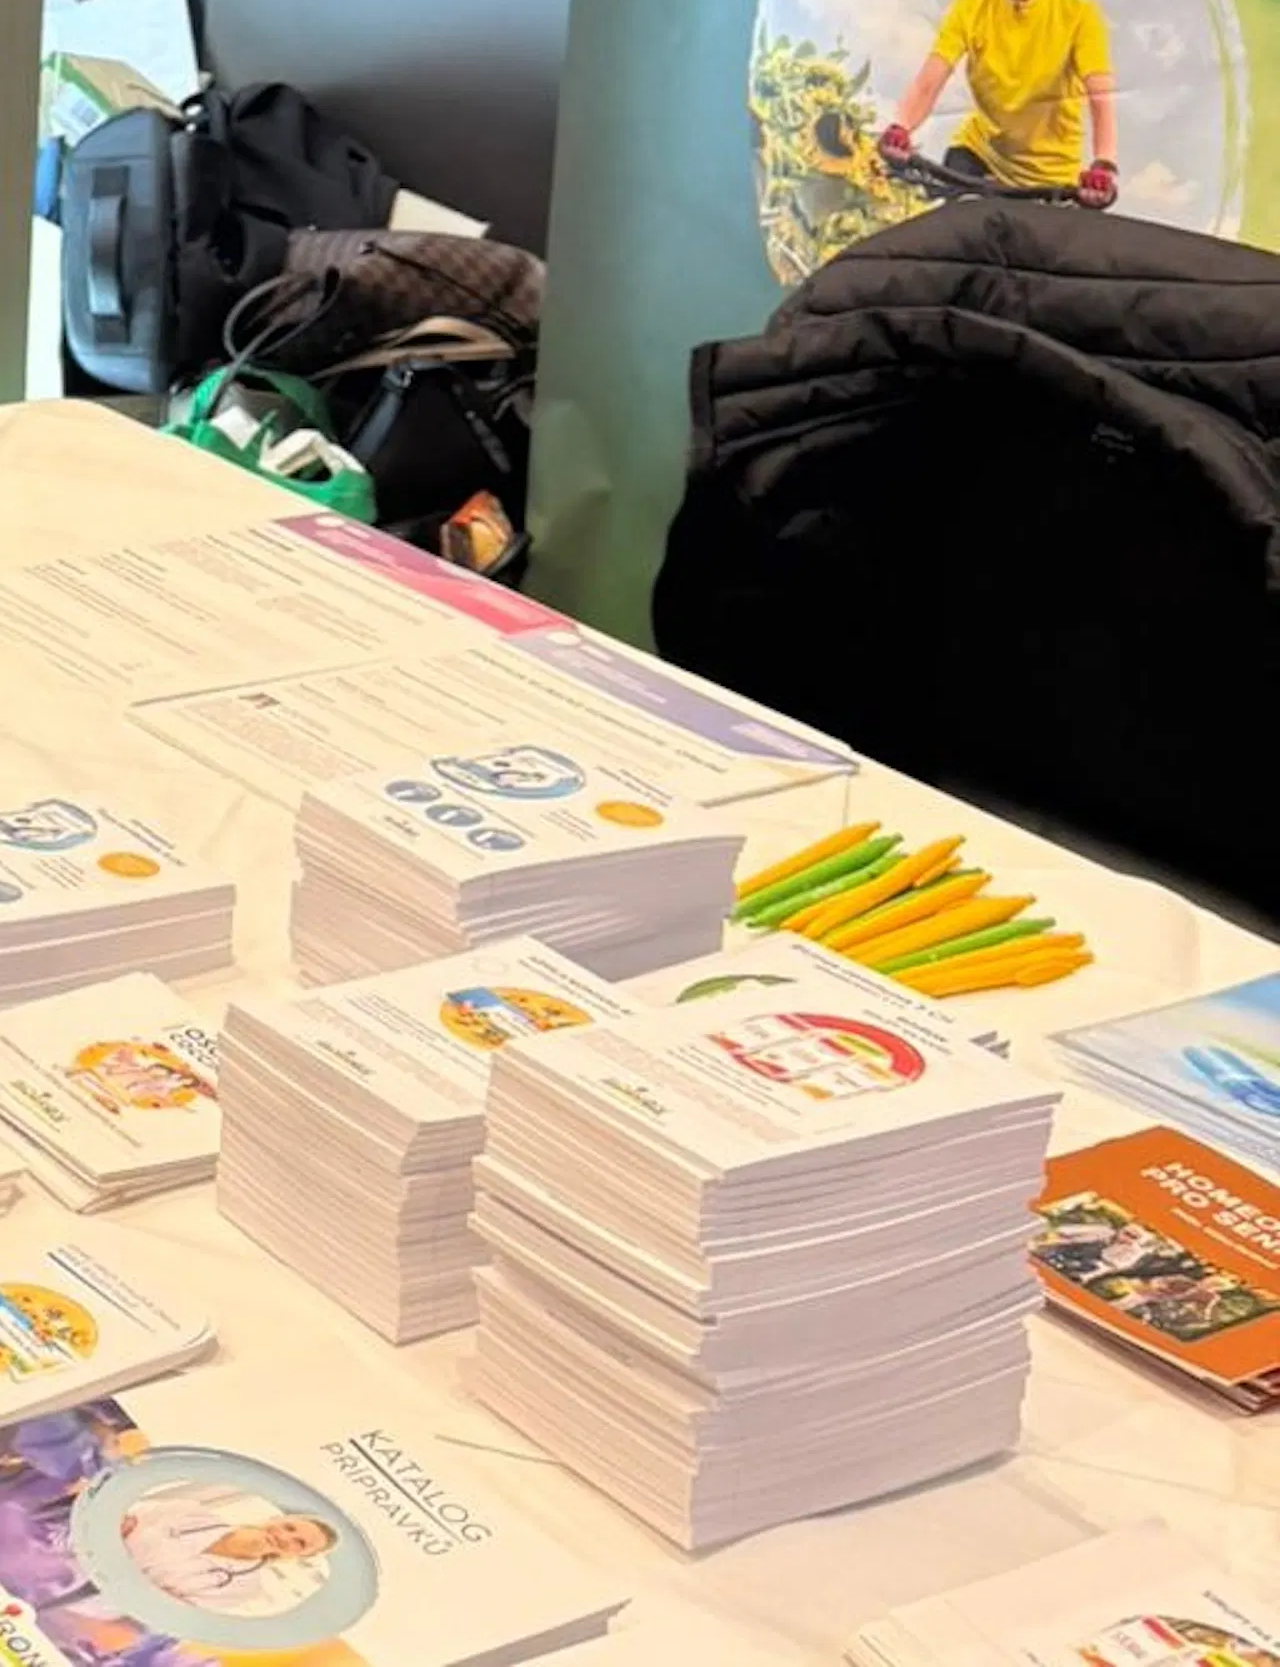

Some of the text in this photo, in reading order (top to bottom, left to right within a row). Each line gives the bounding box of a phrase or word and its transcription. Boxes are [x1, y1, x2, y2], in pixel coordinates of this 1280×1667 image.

[1140, 1167, 1280, 1255] PRO SEN
[319, 1442, 455, 1556] PŘÍPRAVKŮ
[359, 1429, 493, 1543] KATALOG
